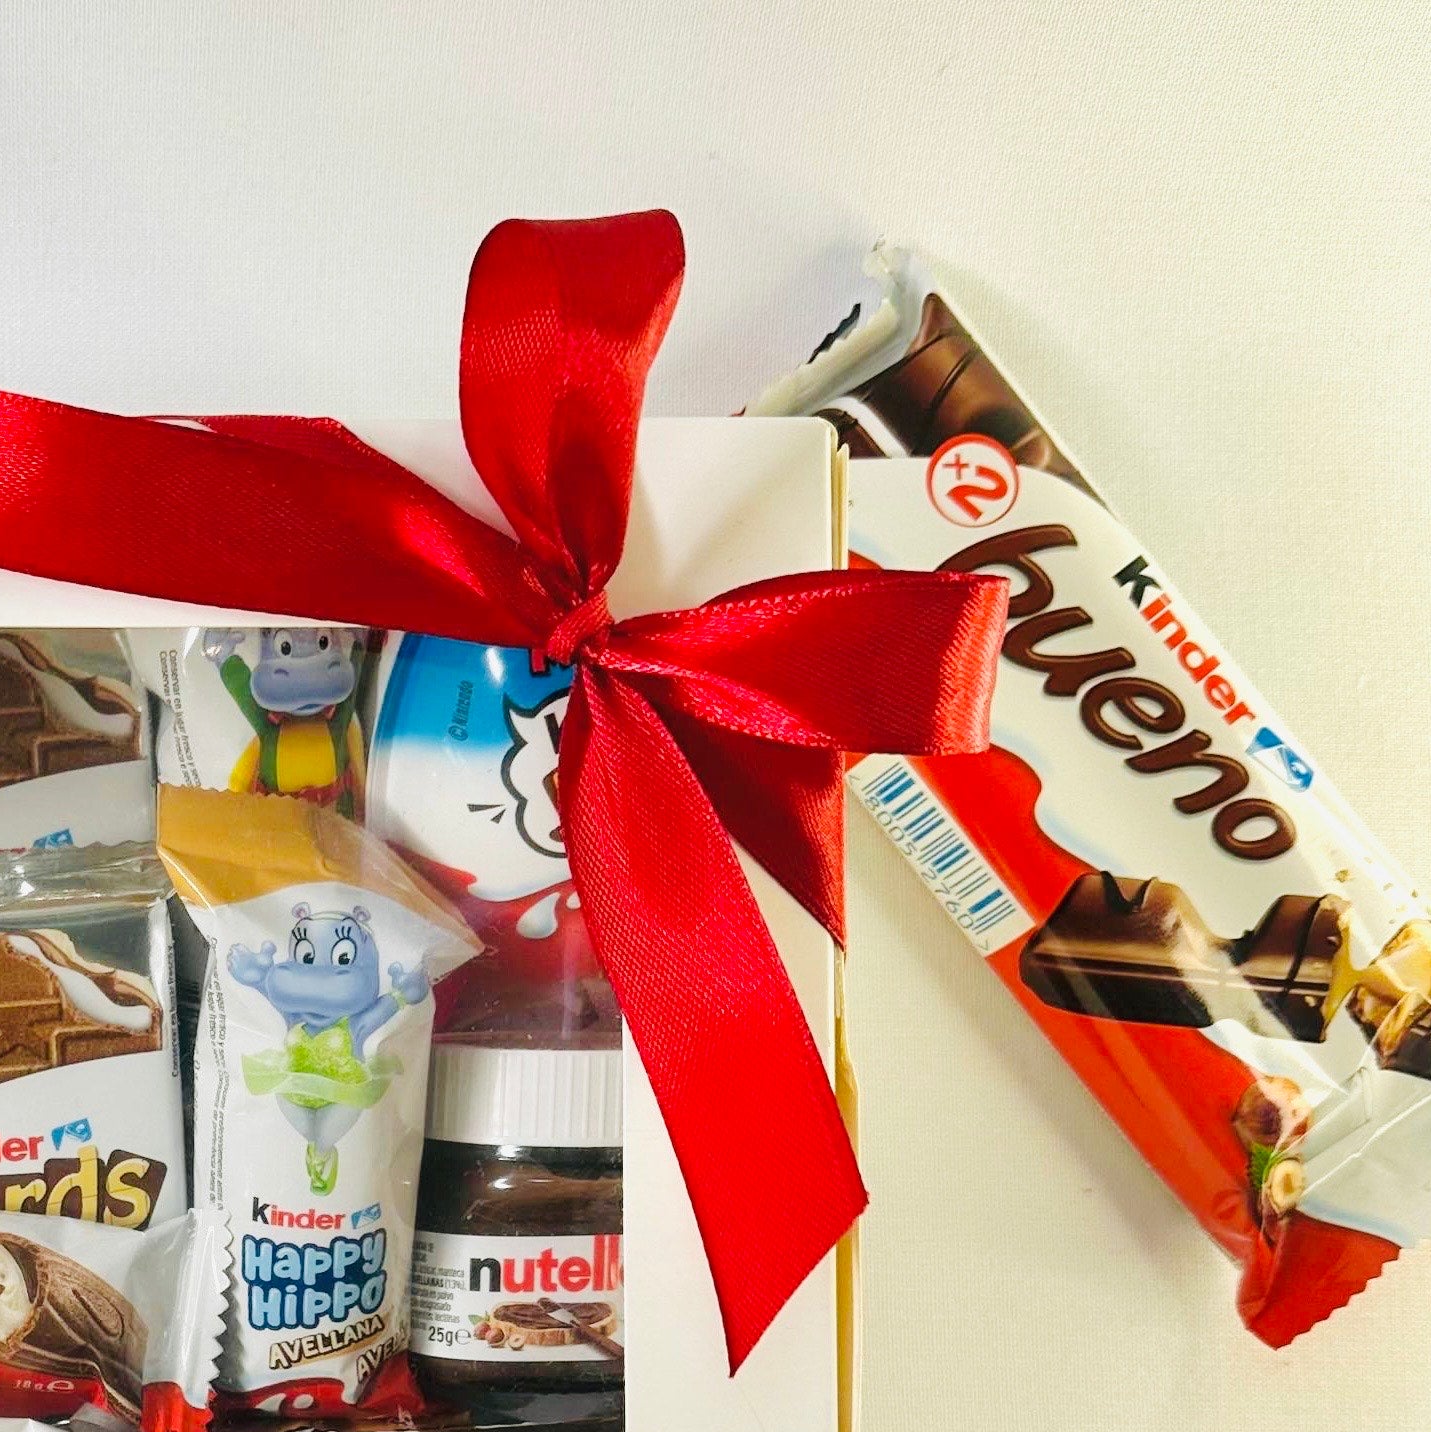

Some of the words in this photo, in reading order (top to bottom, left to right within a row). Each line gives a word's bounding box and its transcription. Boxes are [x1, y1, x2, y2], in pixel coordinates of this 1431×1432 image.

[1113, 555, 1257, 727] kinder
[934, 524, 1297, 860] bueno
[252, 1196, 346, 1231] kinder
[469, 1234, 624, 1293] nutell
[268, 1314, 385, 1370] AVELLANA
